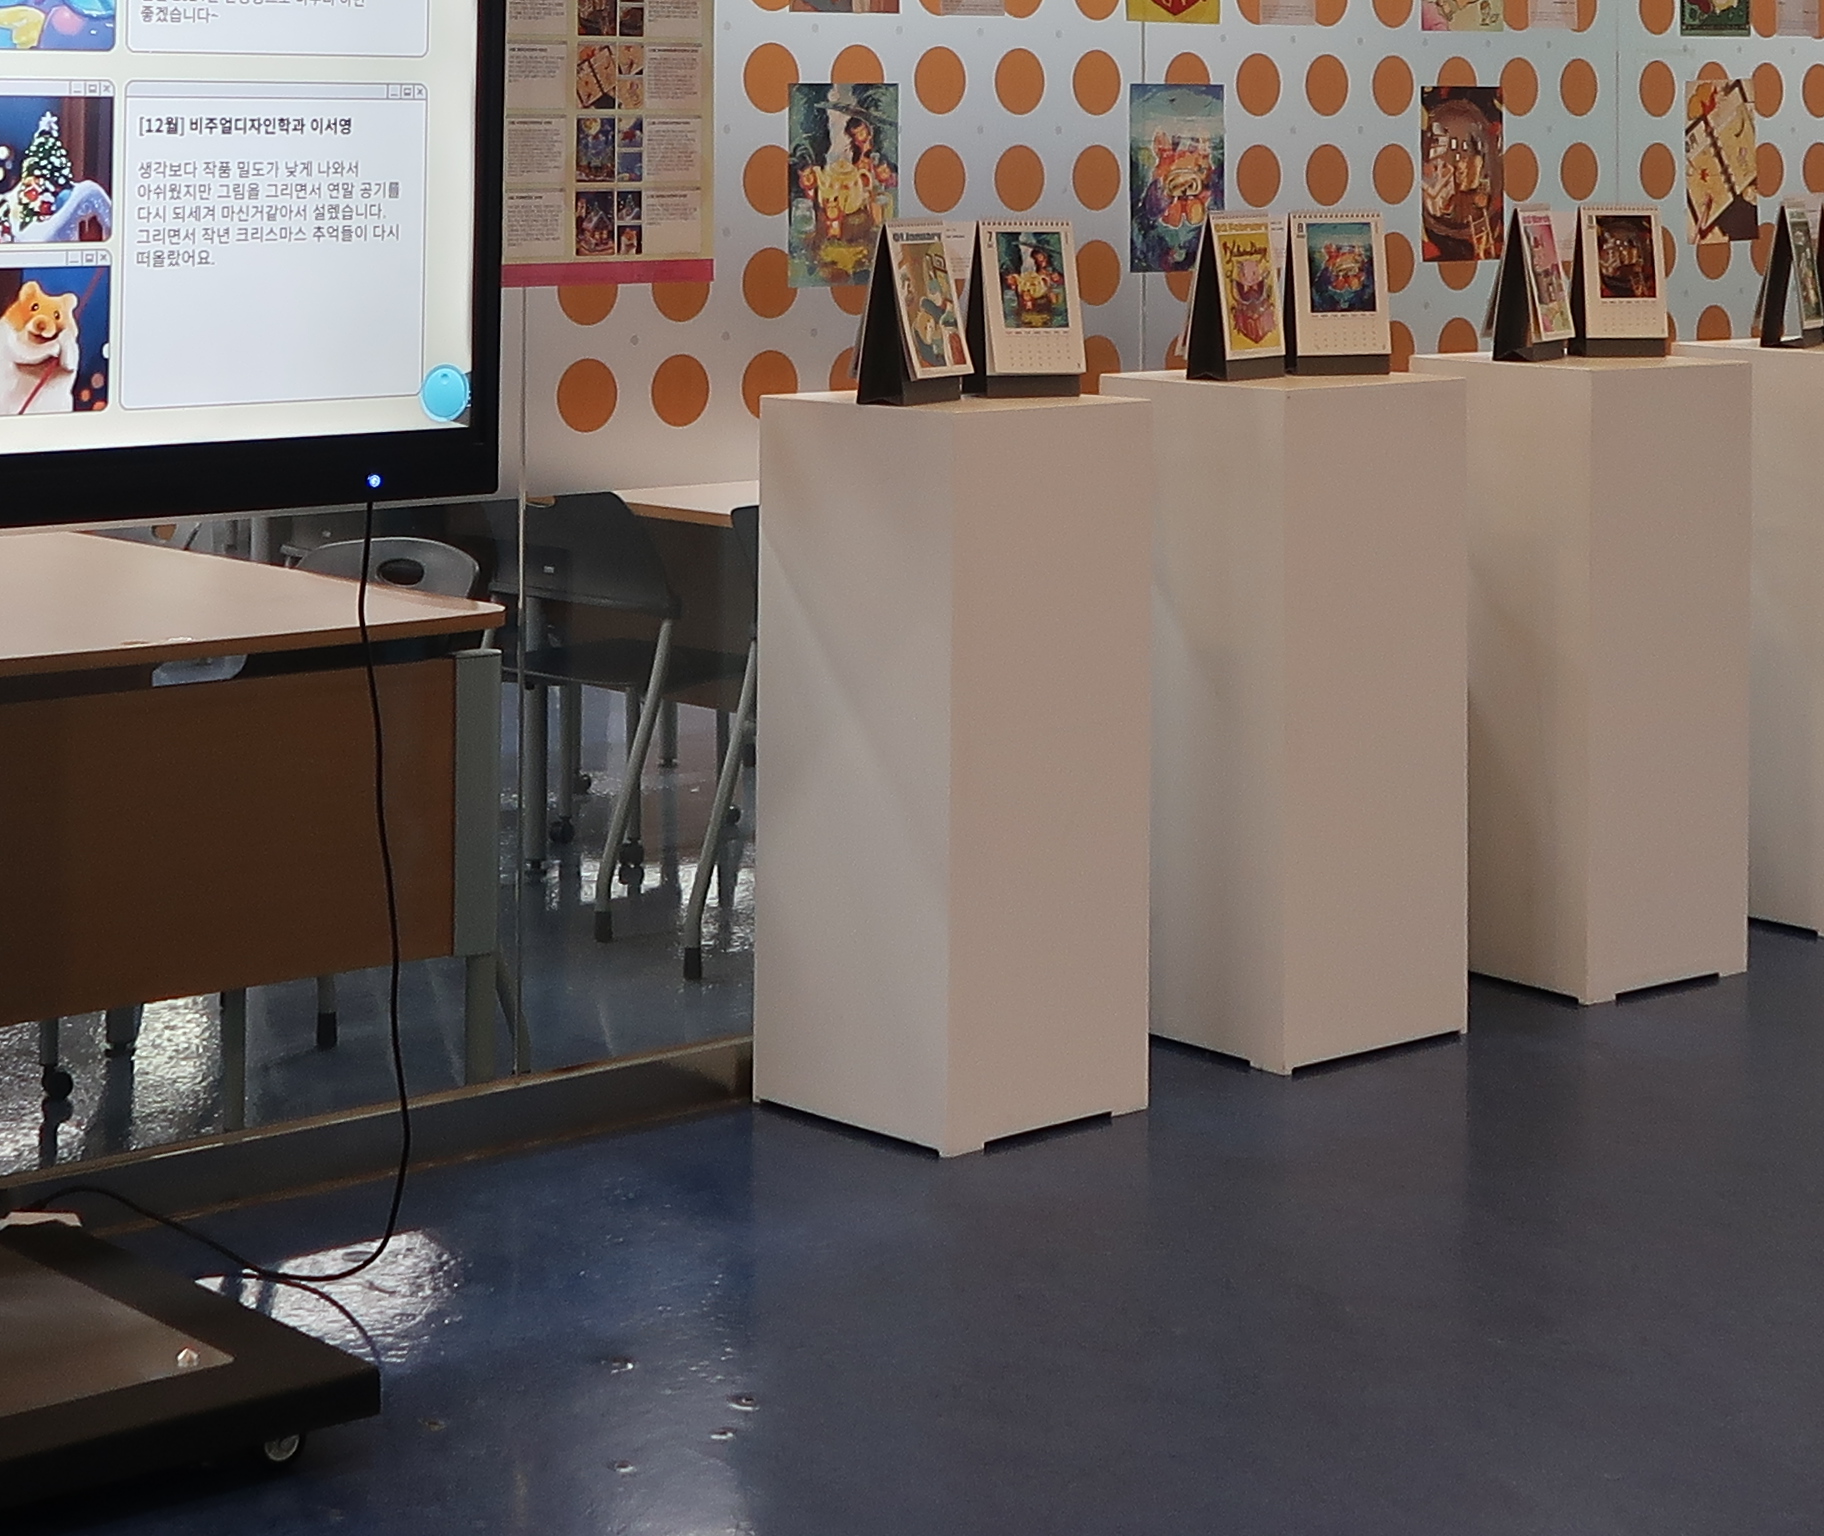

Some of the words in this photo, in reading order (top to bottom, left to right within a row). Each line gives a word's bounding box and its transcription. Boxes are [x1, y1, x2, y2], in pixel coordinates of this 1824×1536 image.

[138, 115, 185, 136] [12월]
[188, 115, 306, 135] 비주얼디자인학과
[309, 116, 351, 135] 이서영
[137, 160, 198, 179] 생각보다
[202, 160, 232, 179] 작품
[236, 160, 279, 178] 밀도가
[284, 159, 312, 178] 낮게
[317, 159, 358, 179] 나와서
[136, 182, 212, 203] 아쉬웠지만
[216, 182, 260, 201] 그림을
[264, 180, 322, 201] 그리면서
[326, 180, 355, 200] 연말
[136, 204, 166, 223] 다시
[217, 203, 310, 223] 마신거같아서
[136, 226, 196, 246] 그리면서
[200, 225, 230, 245] 작년
[235, 224, 307, 243] 크리스마스
[372, 222, 399, 241] 다시
